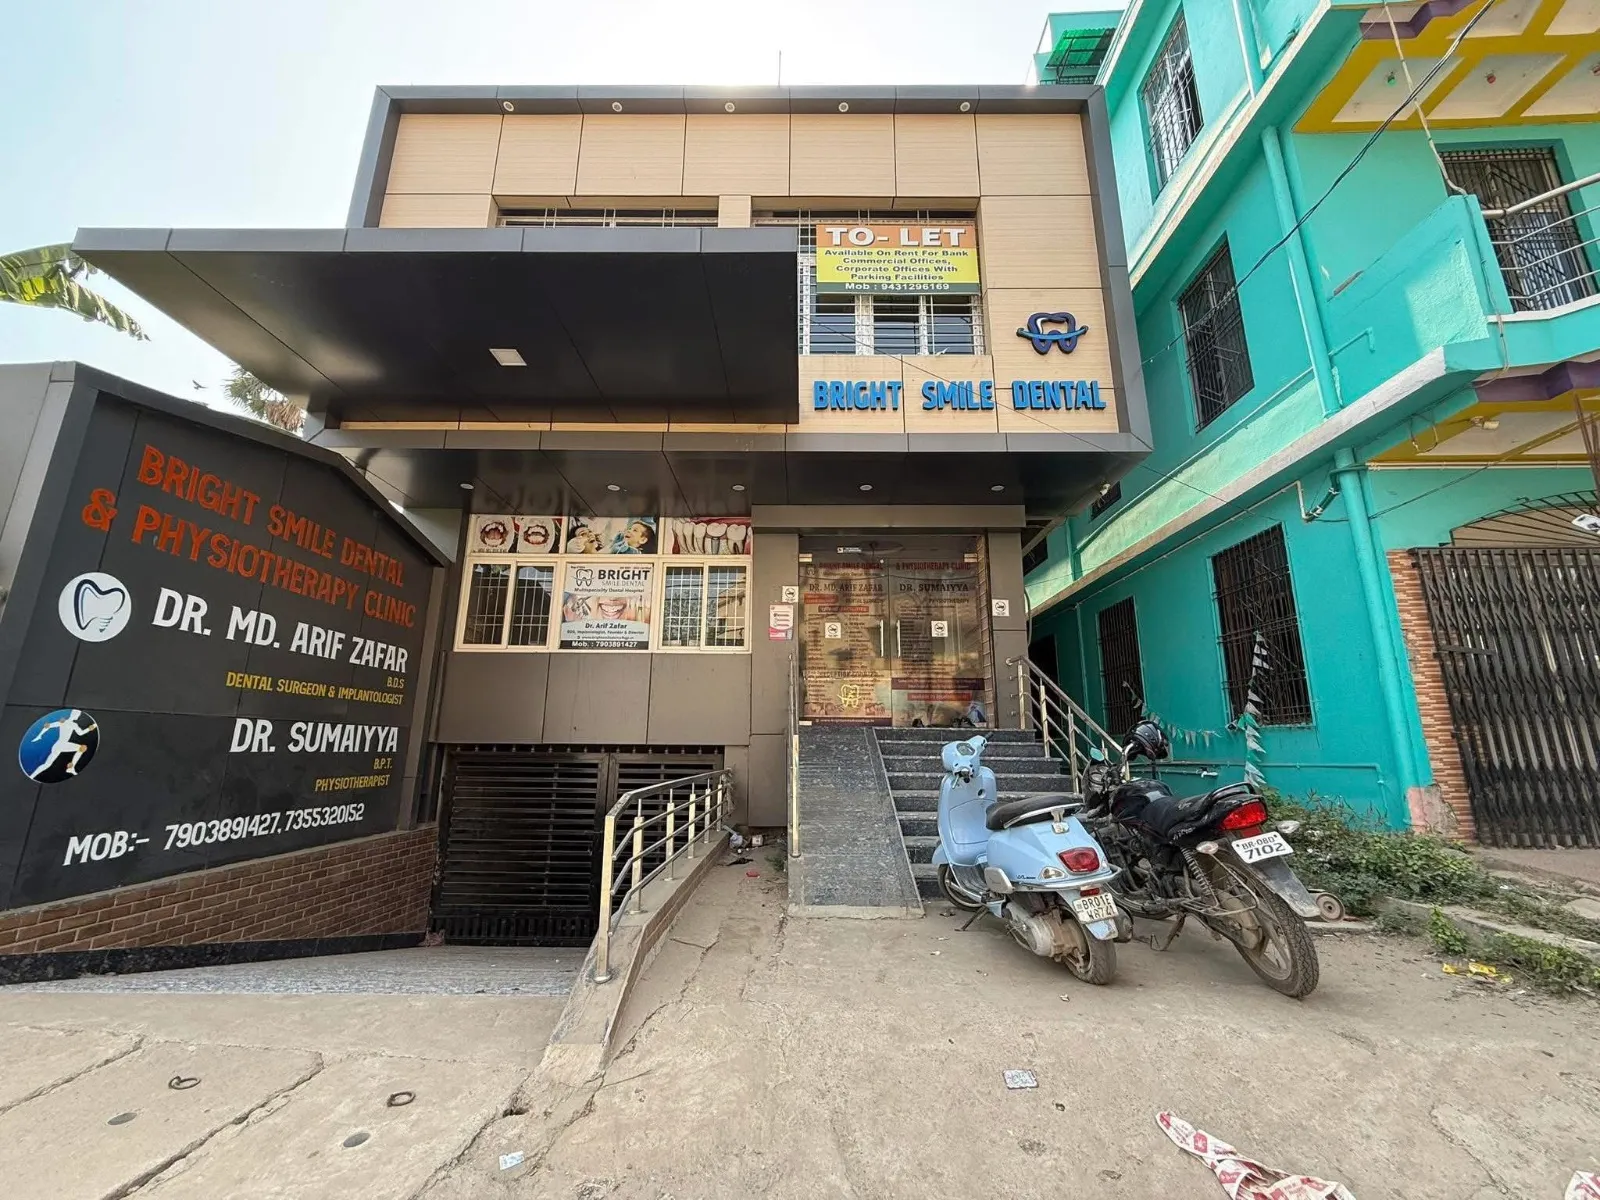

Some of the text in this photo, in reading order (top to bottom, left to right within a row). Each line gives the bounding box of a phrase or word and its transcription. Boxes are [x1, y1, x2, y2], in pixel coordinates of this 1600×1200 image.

[900, 228, 966, 247] LET
[813, 380, 1106, 411] BRIGHT SMILE DENTAL
[137, 444, 405, 588] BRIGHT SMILE DENTAL
[81, 488, 416, 628] & PHYSIOTHERAPY CLINIC
[598, 570, 650, 580] BRIGHT
[859, 584, 883, 592] ZAFAR
[900, 584, 968, 592] DR. SUMAIYYA
[153, 588, 408, 672] DR. MD. ARIF ZAFAR
[226, 672, 403, 705] DENTAL SURGEON & IMPLANTOLOGIST
[229, 718, 398, 754] DR. SUMAIYYA
[315, 774, 390, 791] PHYSIOTHERAPIST
[1245, 843, 1286, 859] 7102
